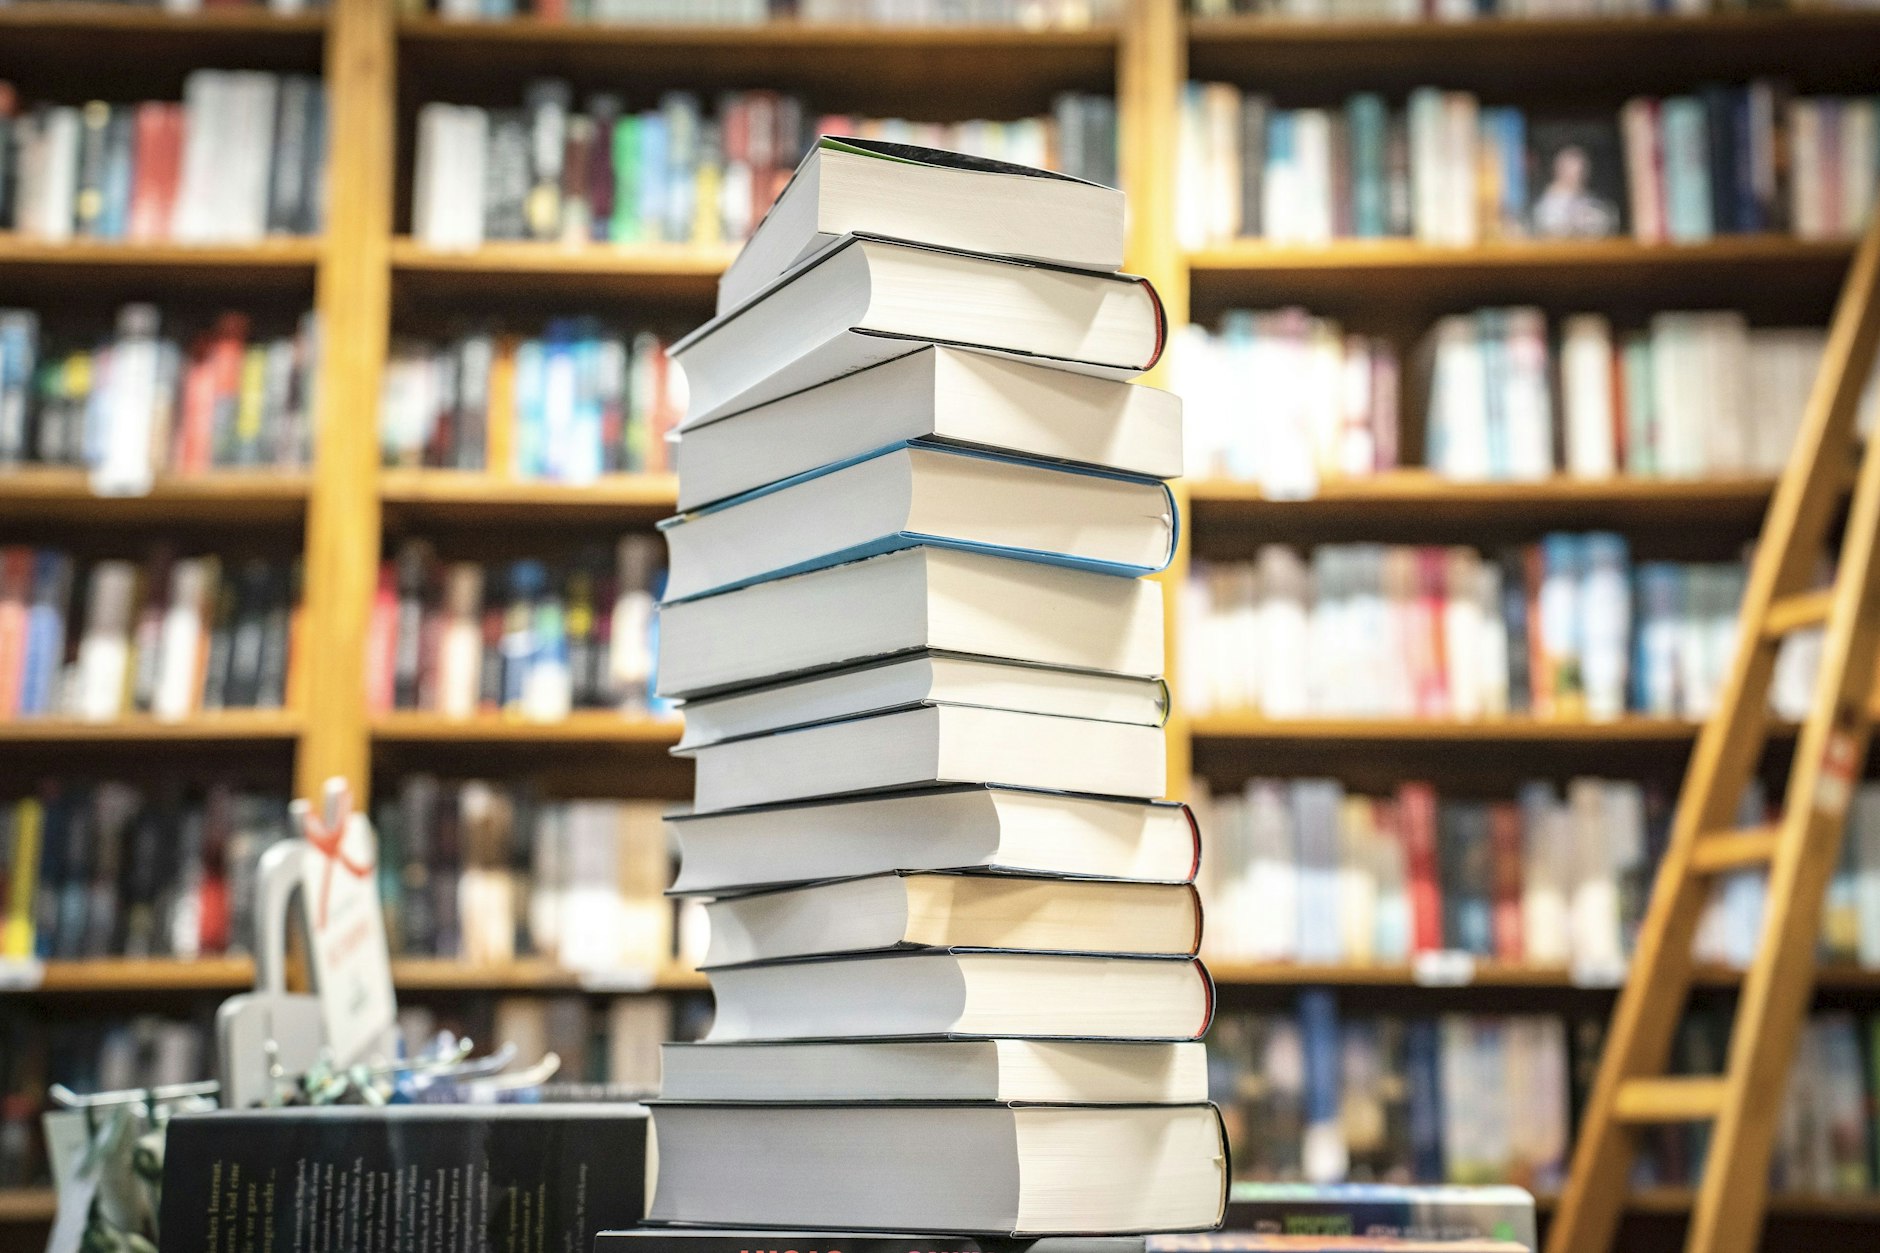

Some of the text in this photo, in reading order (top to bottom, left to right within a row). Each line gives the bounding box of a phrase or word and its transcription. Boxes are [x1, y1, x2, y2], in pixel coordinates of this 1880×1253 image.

[230, 1163, 240, 1189] eine
[206, 1159, 222, 1253] ischen Internat.
[225, 1192, 238, 1220] Und
[248, 1182, 258, 1212] ganz
